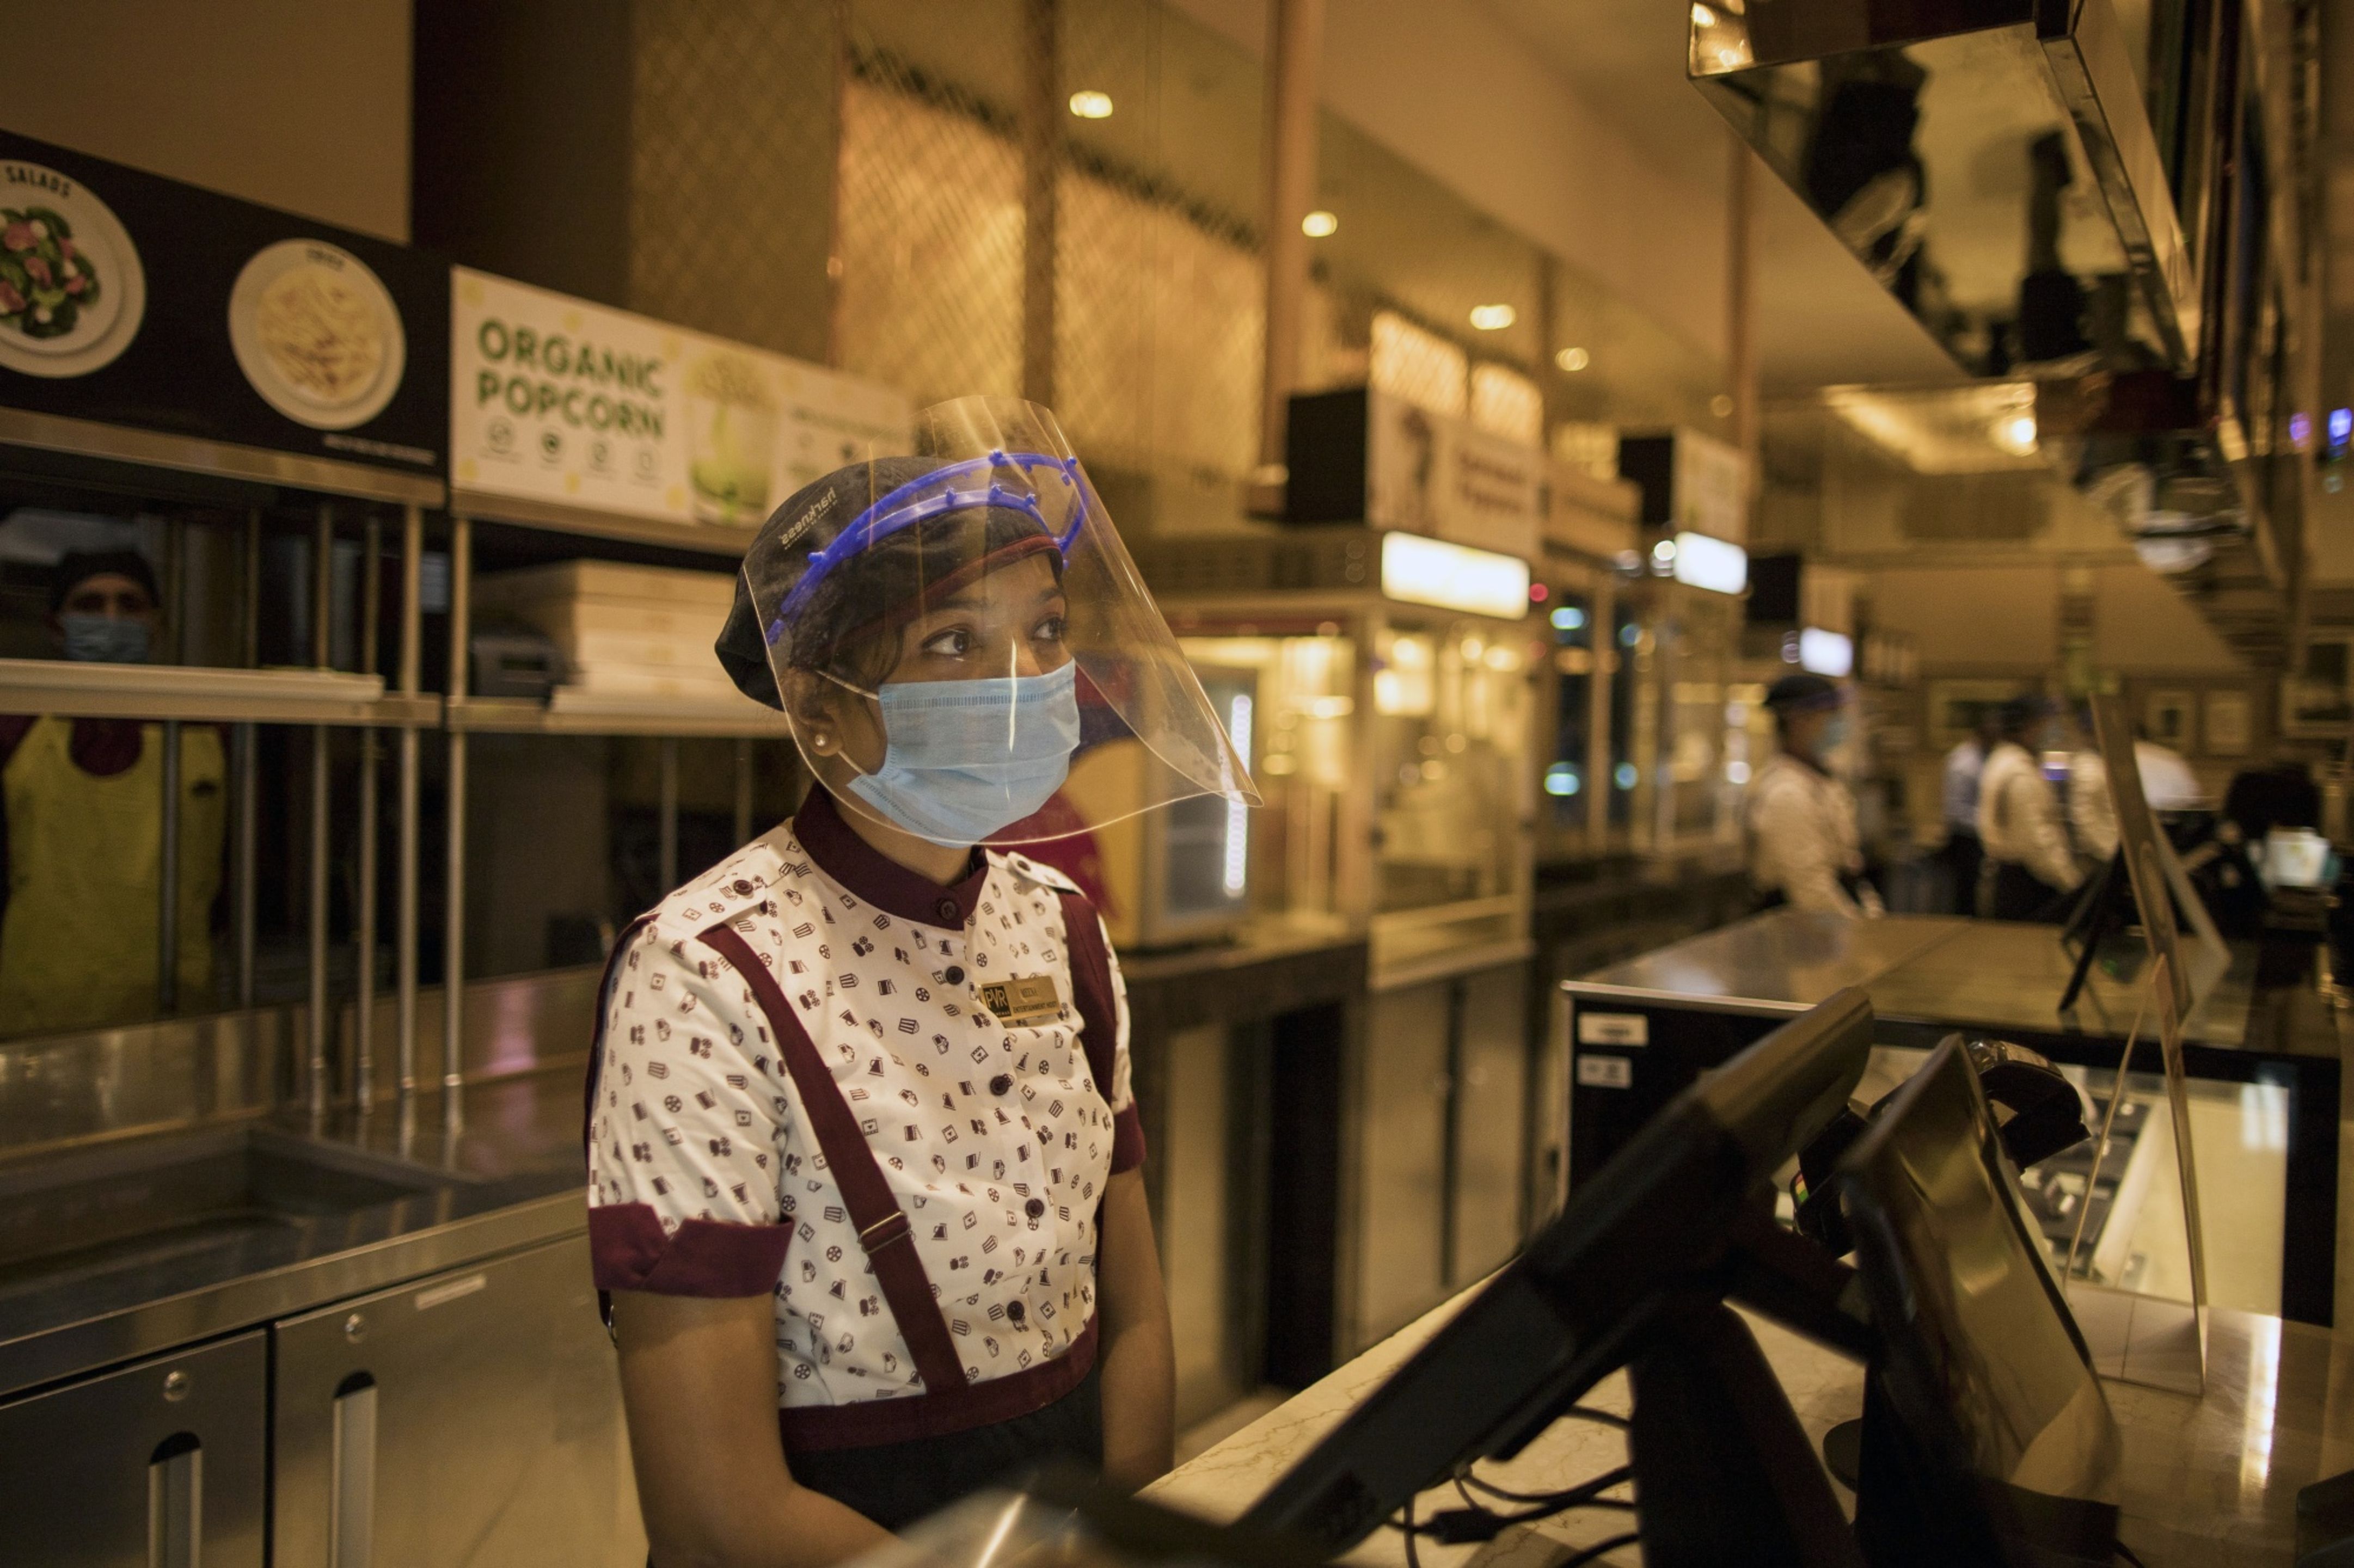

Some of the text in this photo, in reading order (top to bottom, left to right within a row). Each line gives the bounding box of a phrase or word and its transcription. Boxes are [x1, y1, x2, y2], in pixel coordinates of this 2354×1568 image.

[5, 165, 70, 198] SALADS
[478, 318, 663, 399] ORGANIC
[478, 369, 663, 439] POPCORN
[985, 988, 1007, 1007] PVR
[1013, 1003, 1046, 1013] ENTERTAINMENT
